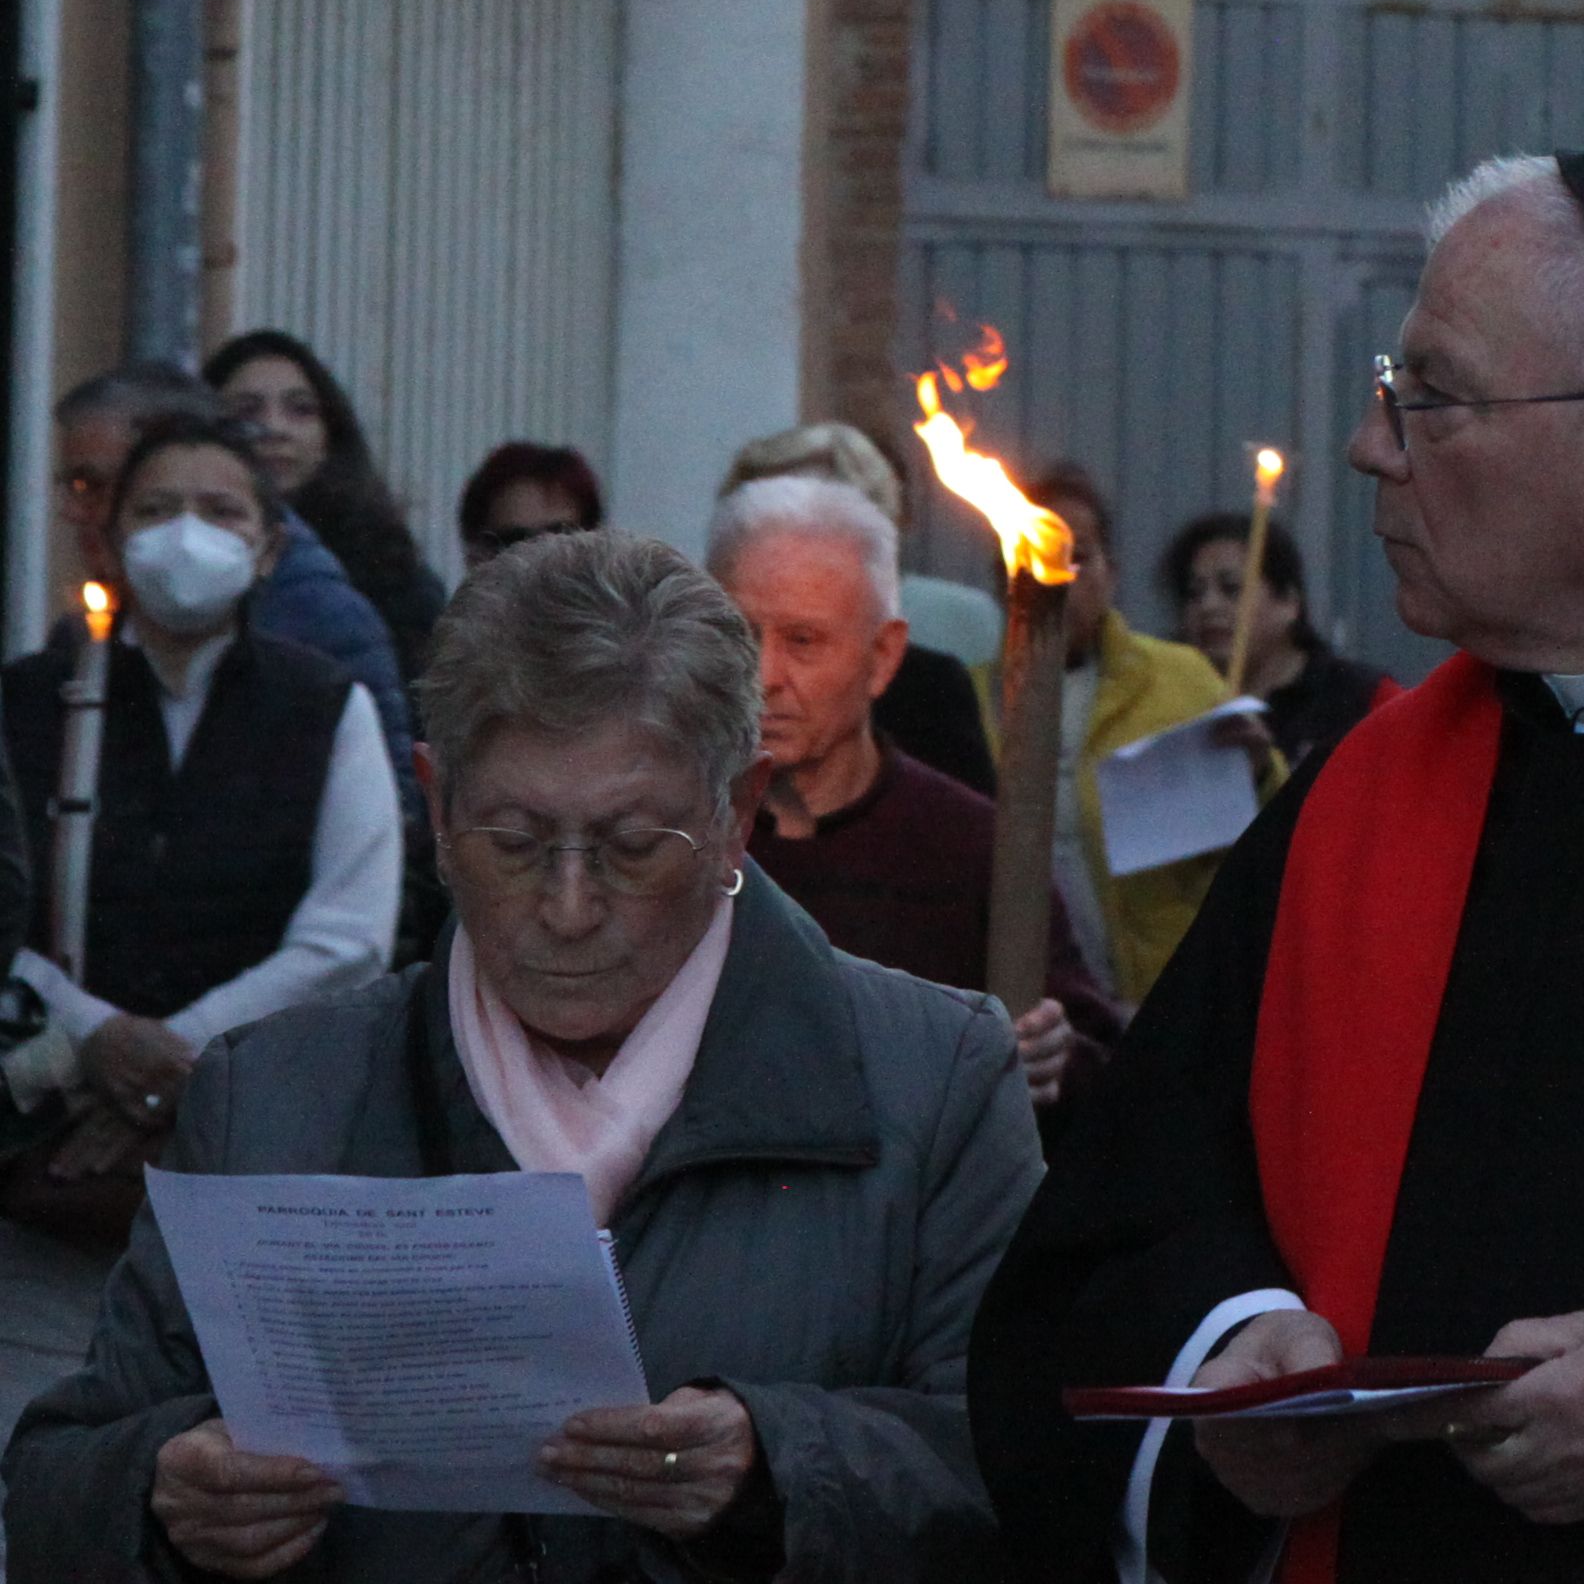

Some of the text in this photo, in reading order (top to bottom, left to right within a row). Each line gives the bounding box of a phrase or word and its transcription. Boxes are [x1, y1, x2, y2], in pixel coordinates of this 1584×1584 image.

[257, 1205, 495, 1218] PARROQUIA DE SANT ESTEVE
